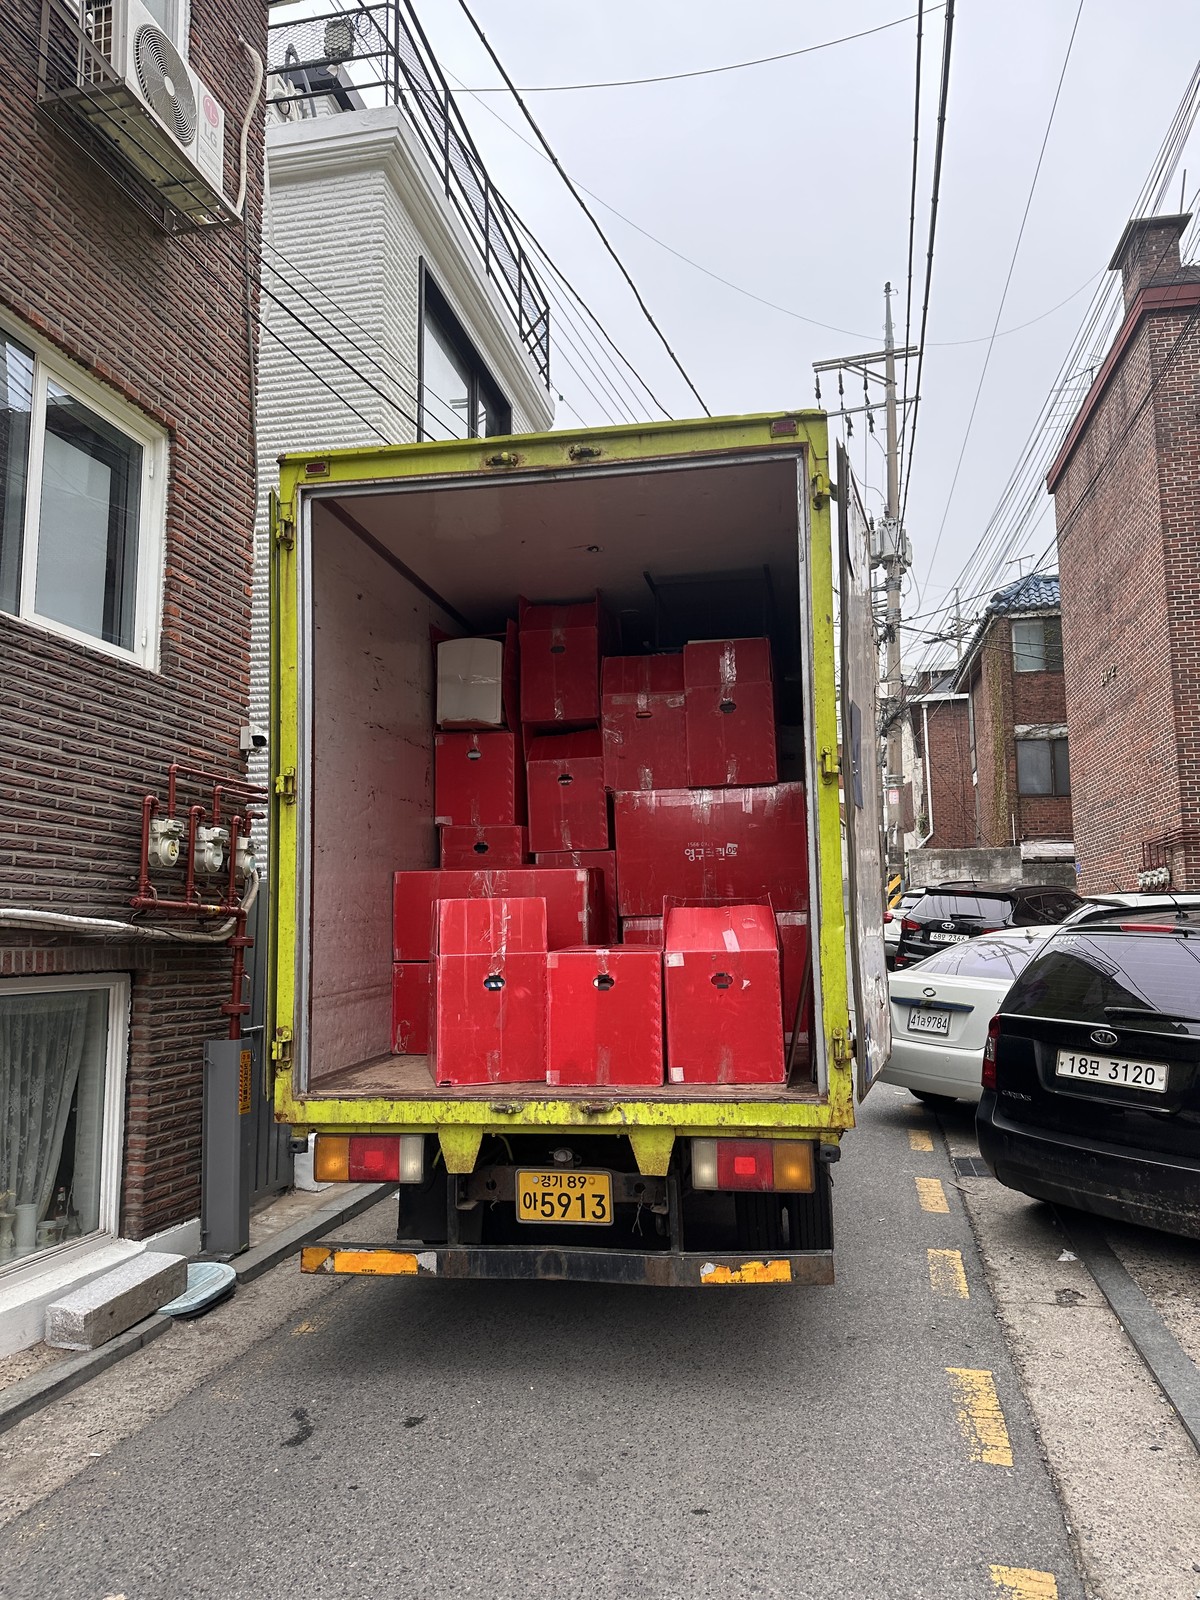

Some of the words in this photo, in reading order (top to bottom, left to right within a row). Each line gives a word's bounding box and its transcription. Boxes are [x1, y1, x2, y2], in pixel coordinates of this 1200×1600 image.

[204, 122, 217, 148] LG
[1094, 1032, 1114, 1043] KIA
[1069, 1056, 1100, 1076] 18모
[1108, 1062, 1155, 1085] 3120
[541, 1175, 563, 1188] 경기
[567, 1176, 587, 1189] 89
[523, 1192, 606, 1219] 아5913
